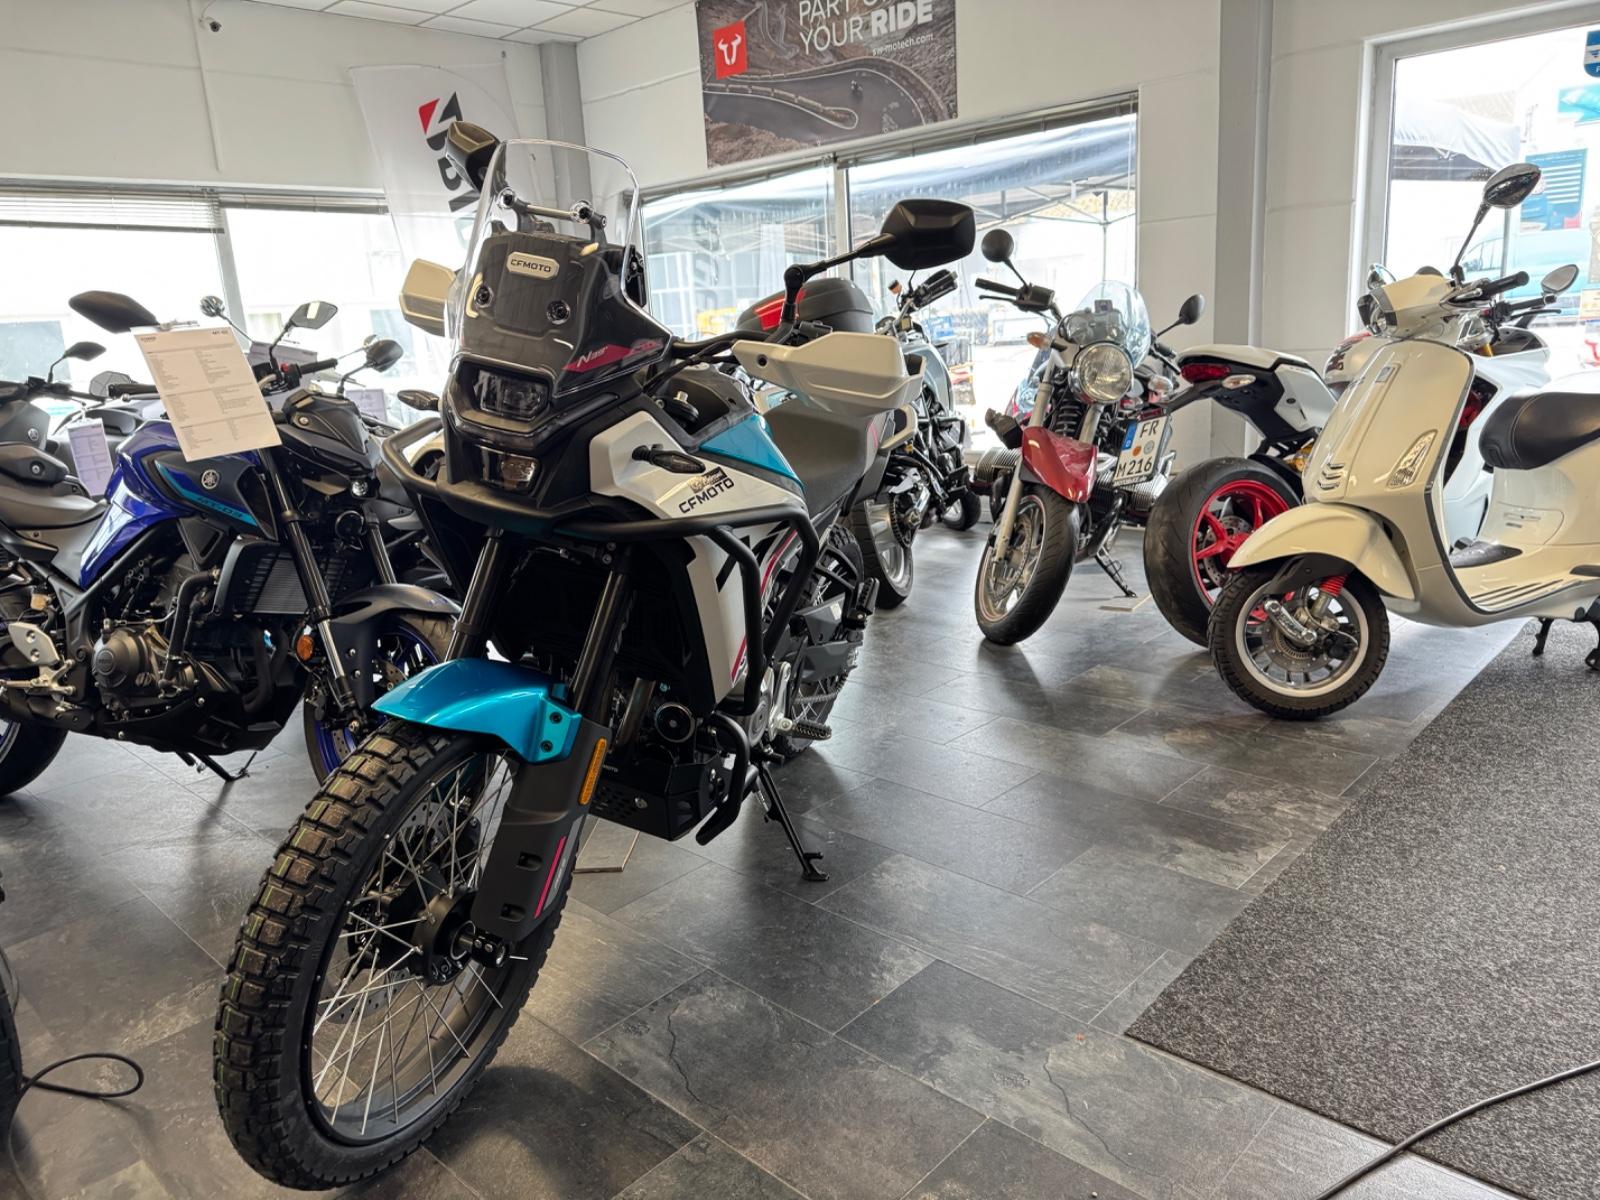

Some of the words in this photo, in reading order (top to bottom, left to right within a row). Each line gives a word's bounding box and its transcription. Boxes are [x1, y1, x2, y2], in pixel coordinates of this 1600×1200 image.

[799, 16, 863, 55] YOUR
[871, 0, 933, 37] RIDE
[510, 259, 552, 273] CFMOTO
[1139, 420, 1159, 438] FR
[678, 478, 735, 514] CFMOTO
